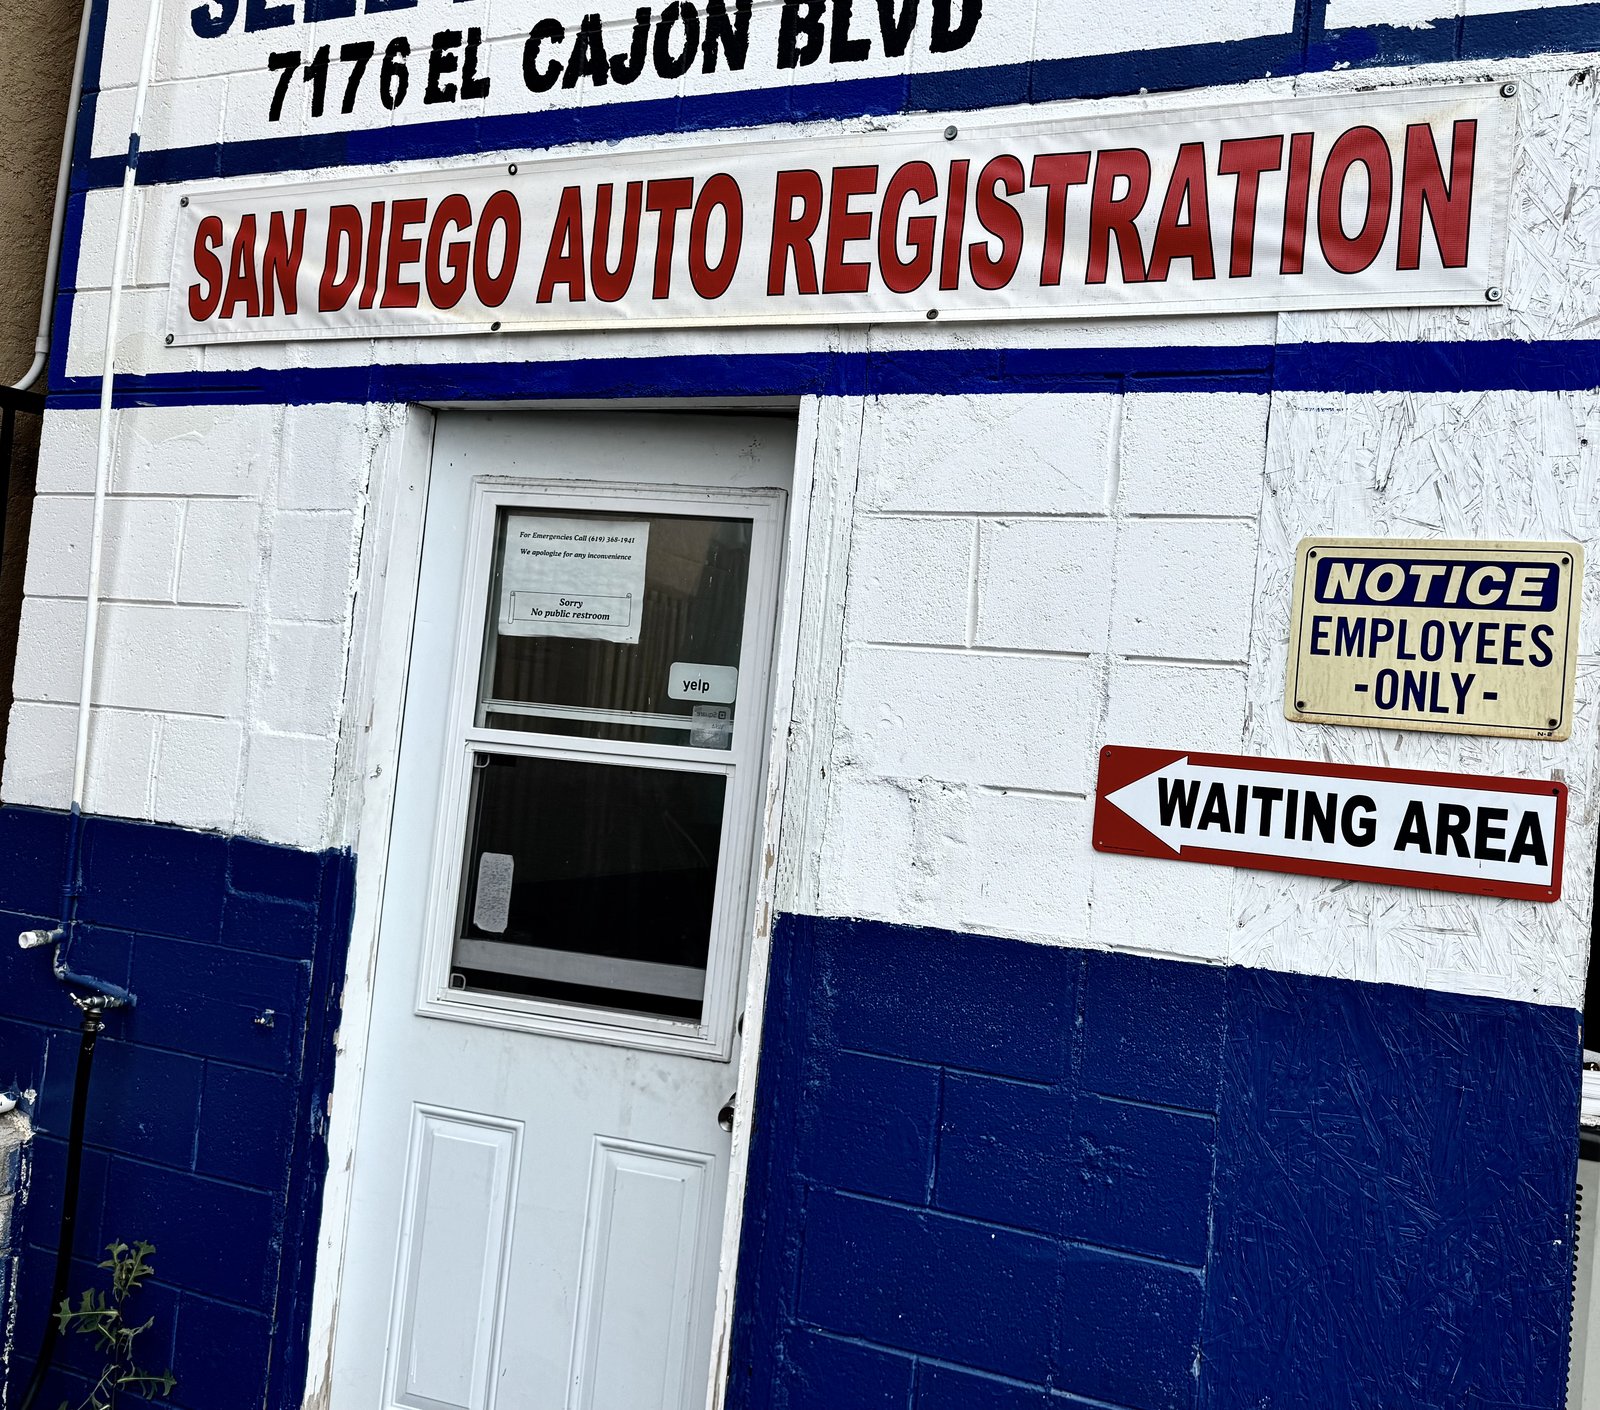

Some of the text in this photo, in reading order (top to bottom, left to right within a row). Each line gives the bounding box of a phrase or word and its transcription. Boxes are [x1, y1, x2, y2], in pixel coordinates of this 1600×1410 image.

[268, 37, 411, 122] 7176
[423, 27, 491, 105] EL
[523, 0, 754, 93] CAJON
[776, 0, 983, 70] BLVD
[188, 119, 1477, 322] SAN DIEGO AUTO REGISTRATION
[532, 532, 573, 540] Emergencies
[574, 552, 587, 560] any
[587, 552, 632, 560] inconvenience
[1323, 561, 1550, 606] NOTICE
[530, 608, 610, 621] No public restroom
[559, 598, 584, 609] Sorry
[1310, 615, 1555, 668] EMPLOYEES
[683, 679, 710, 693] yelp
[1158, 777, 1549, 868] WAITING AREA
